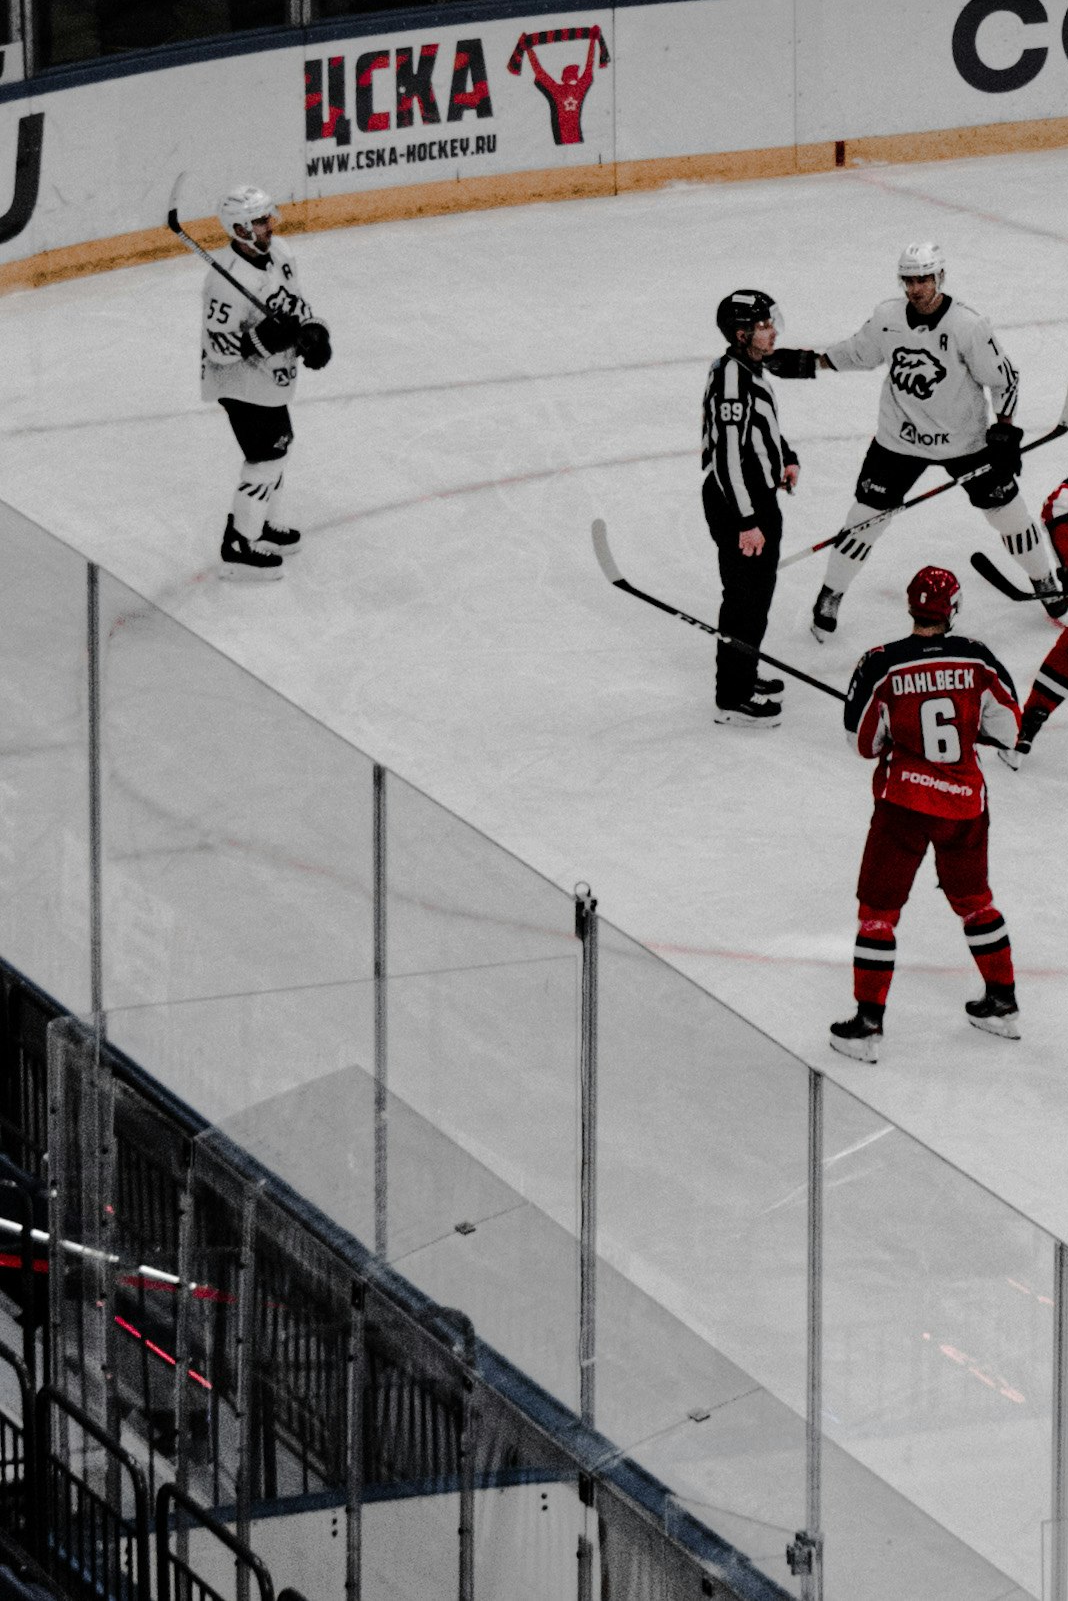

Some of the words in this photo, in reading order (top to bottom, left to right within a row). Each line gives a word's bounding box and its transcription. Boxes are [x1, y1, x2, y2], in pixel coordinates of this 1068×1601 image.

[304, 38, 494, 147] ЦСКА
[306, 133, 498, 178] WWW.CSKA-HOCKEY.RU
[206, 298, 232, 324] 55
[719, 402, 744, 422] 89
[919, 591, 929, 604] 6
[892, 668, 975, 696] DAHLBECK
[920, 697, 962, 764] 6
